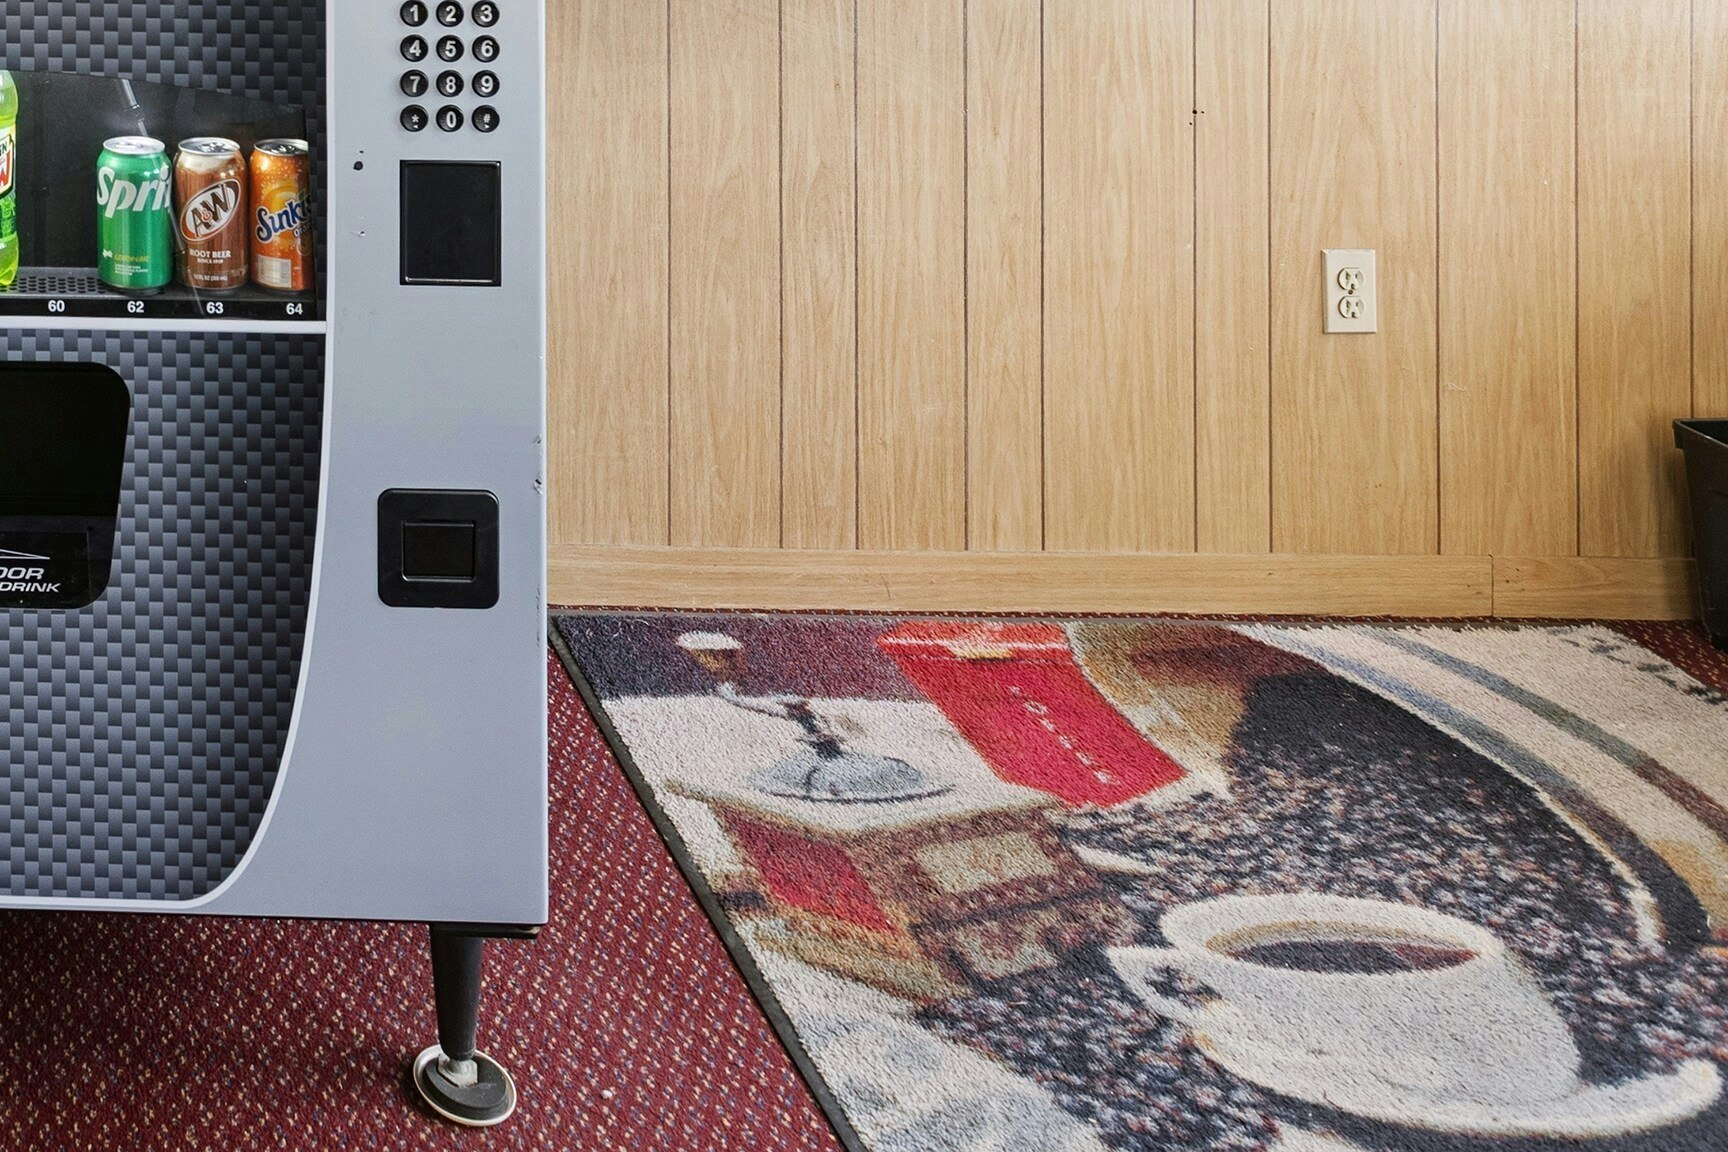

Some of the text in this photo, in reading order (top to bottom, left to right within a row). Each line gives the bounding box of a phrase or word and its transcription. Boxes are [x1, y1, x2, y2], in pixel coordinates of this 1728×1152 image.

[410, 5, 493, 22] 1 2 3
[409, 40, 494, 58] 4 5 6
[410, 75, 494, 93] 7 8 9
[446, 111, 457, 128] 0
[97, 163, 172, 218] Spri
[191, 181, 233, 238] A&W
[189, 249, 232, 258] ROOT BEER
[48, 300, 66, 313] 60
[127, 301, 145, 314] 62
[206, 302, 224, 315] 63
[286, 303, 304, 316] 64
